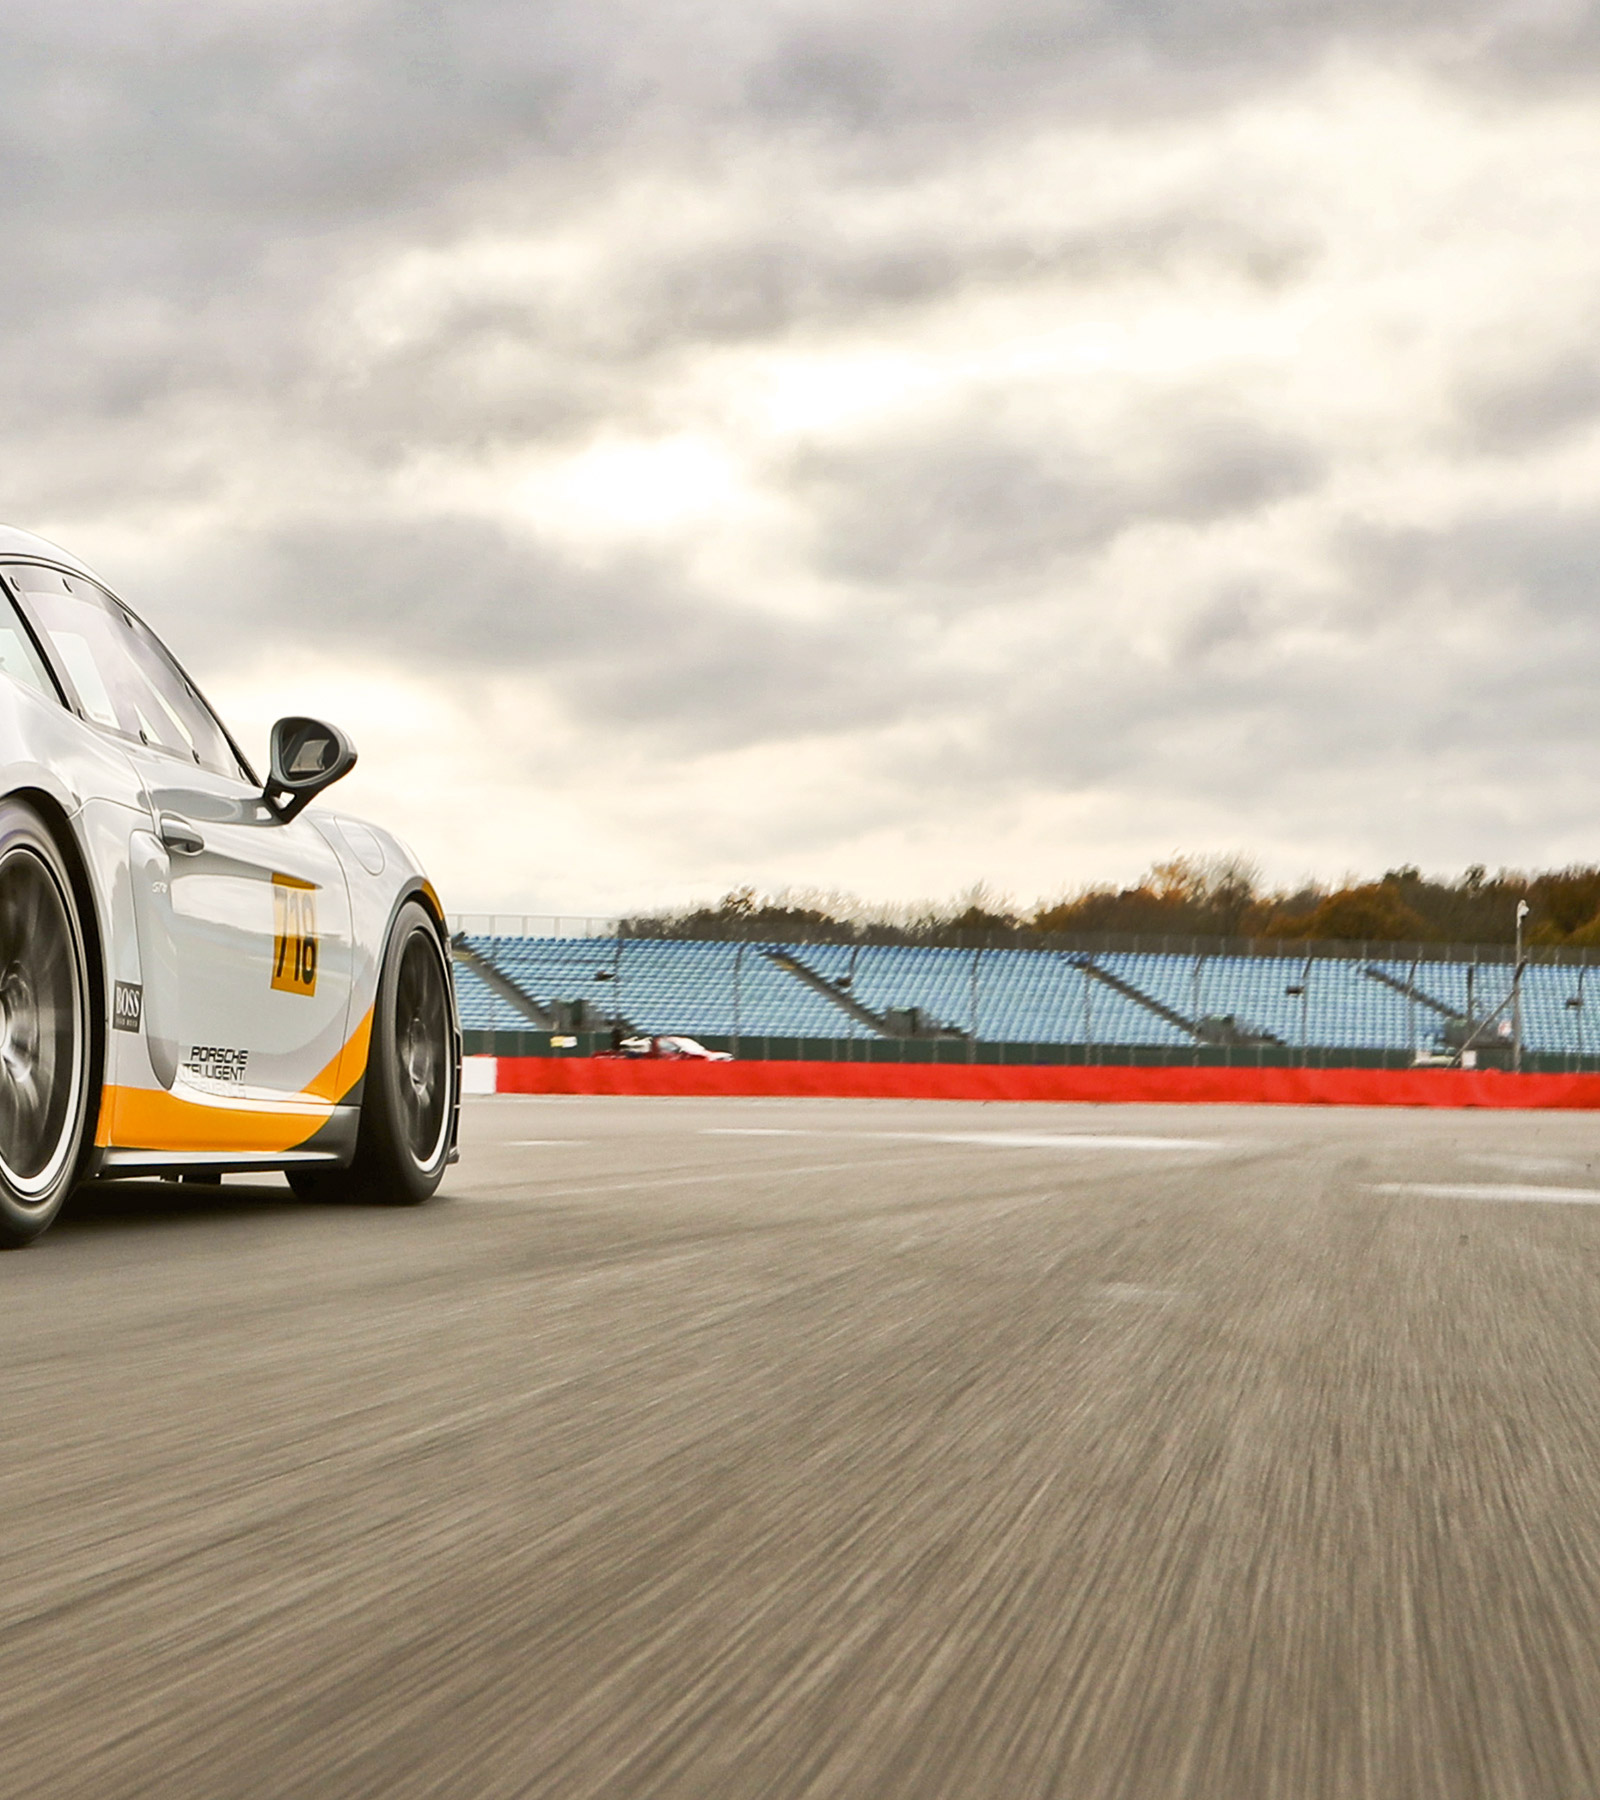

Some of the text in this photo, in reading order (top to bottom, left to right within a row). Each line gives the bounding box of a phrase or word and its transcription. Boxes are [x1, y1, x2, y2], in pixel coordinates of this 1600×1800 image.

[273, 885, 317, 985] 718
[115, 986, 140, 1018] BOSS
[190, 1046, 248, 1065] PORSCHE
